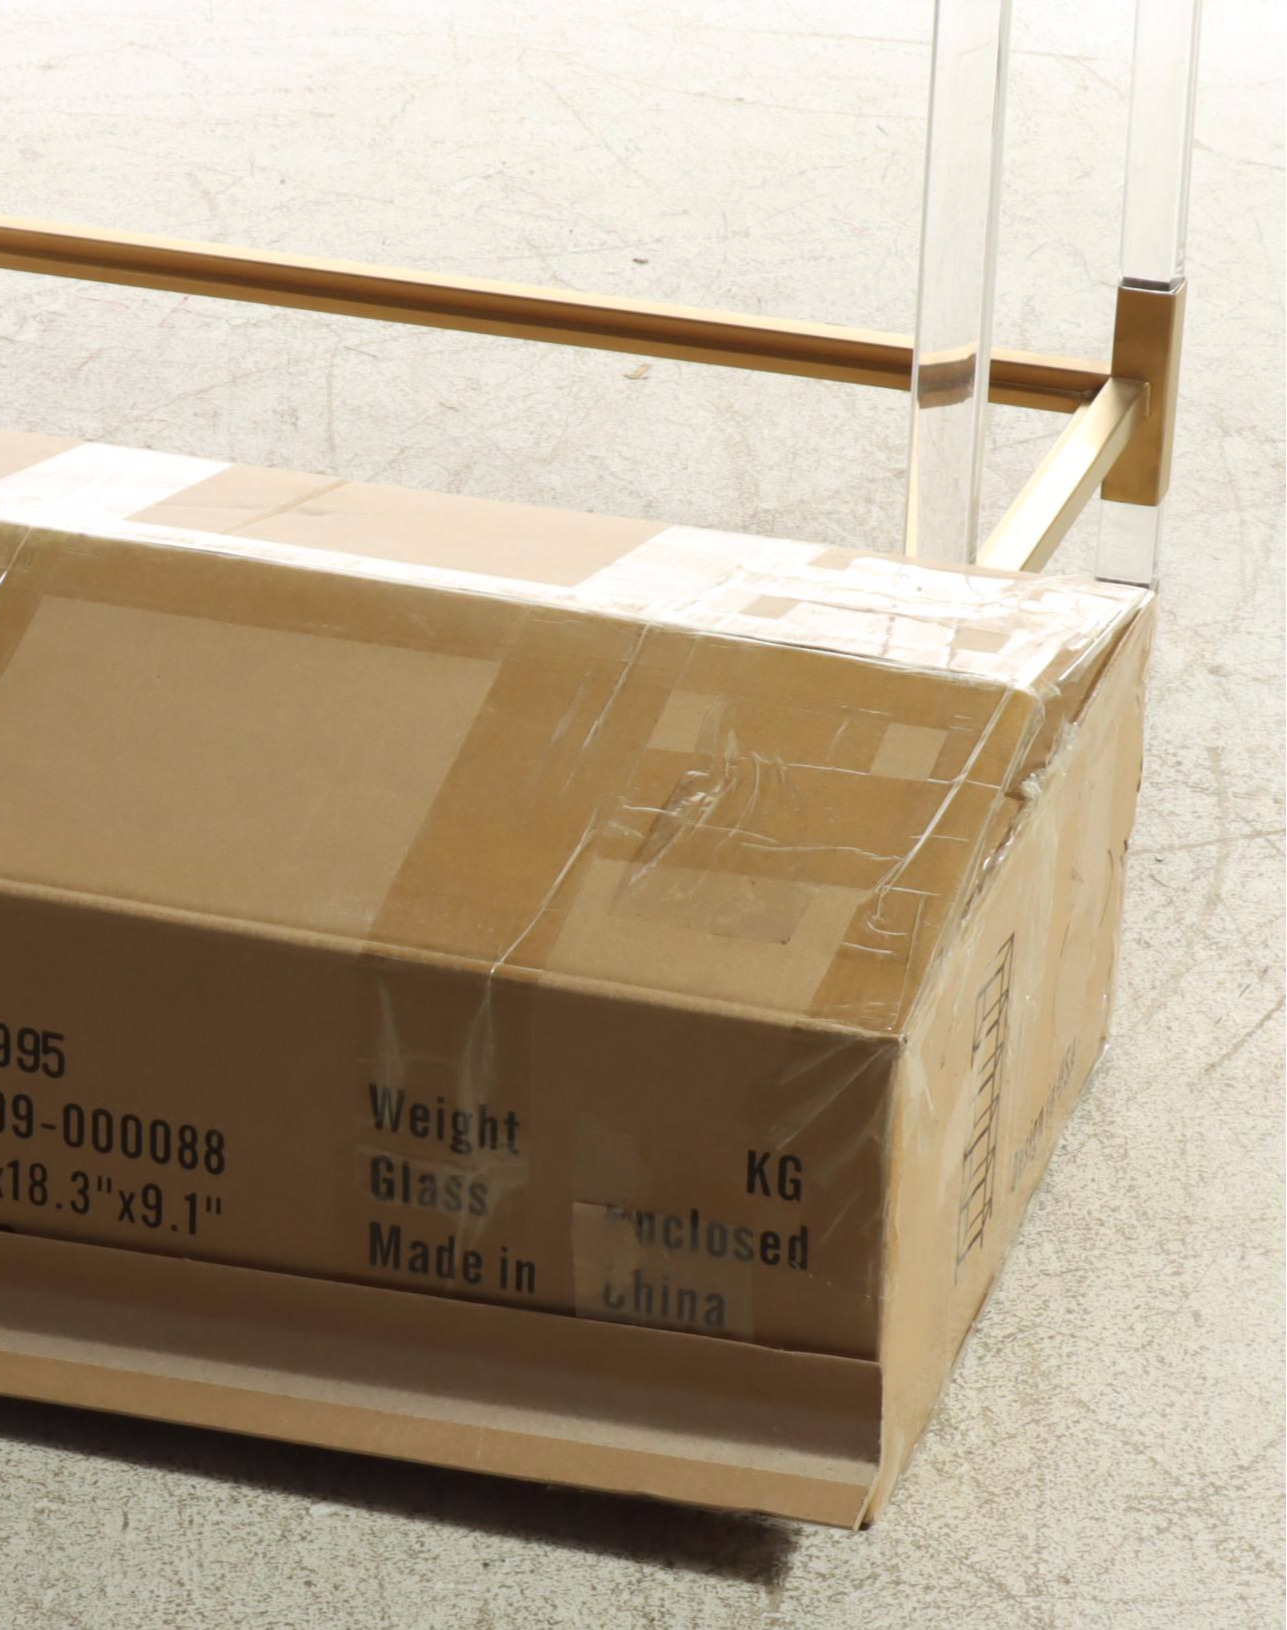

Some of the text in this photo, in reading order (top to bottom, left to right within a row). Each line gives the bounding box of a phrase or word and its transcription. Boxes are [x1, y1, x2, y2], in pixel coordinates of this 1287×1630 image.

[369, 1083, 802, 1202] Weight KG
[369, 1221, 482, 1285] Made
[500, 1247, 536, 1294] in
[370, 1155, 809, 1269] Glass nclosed
